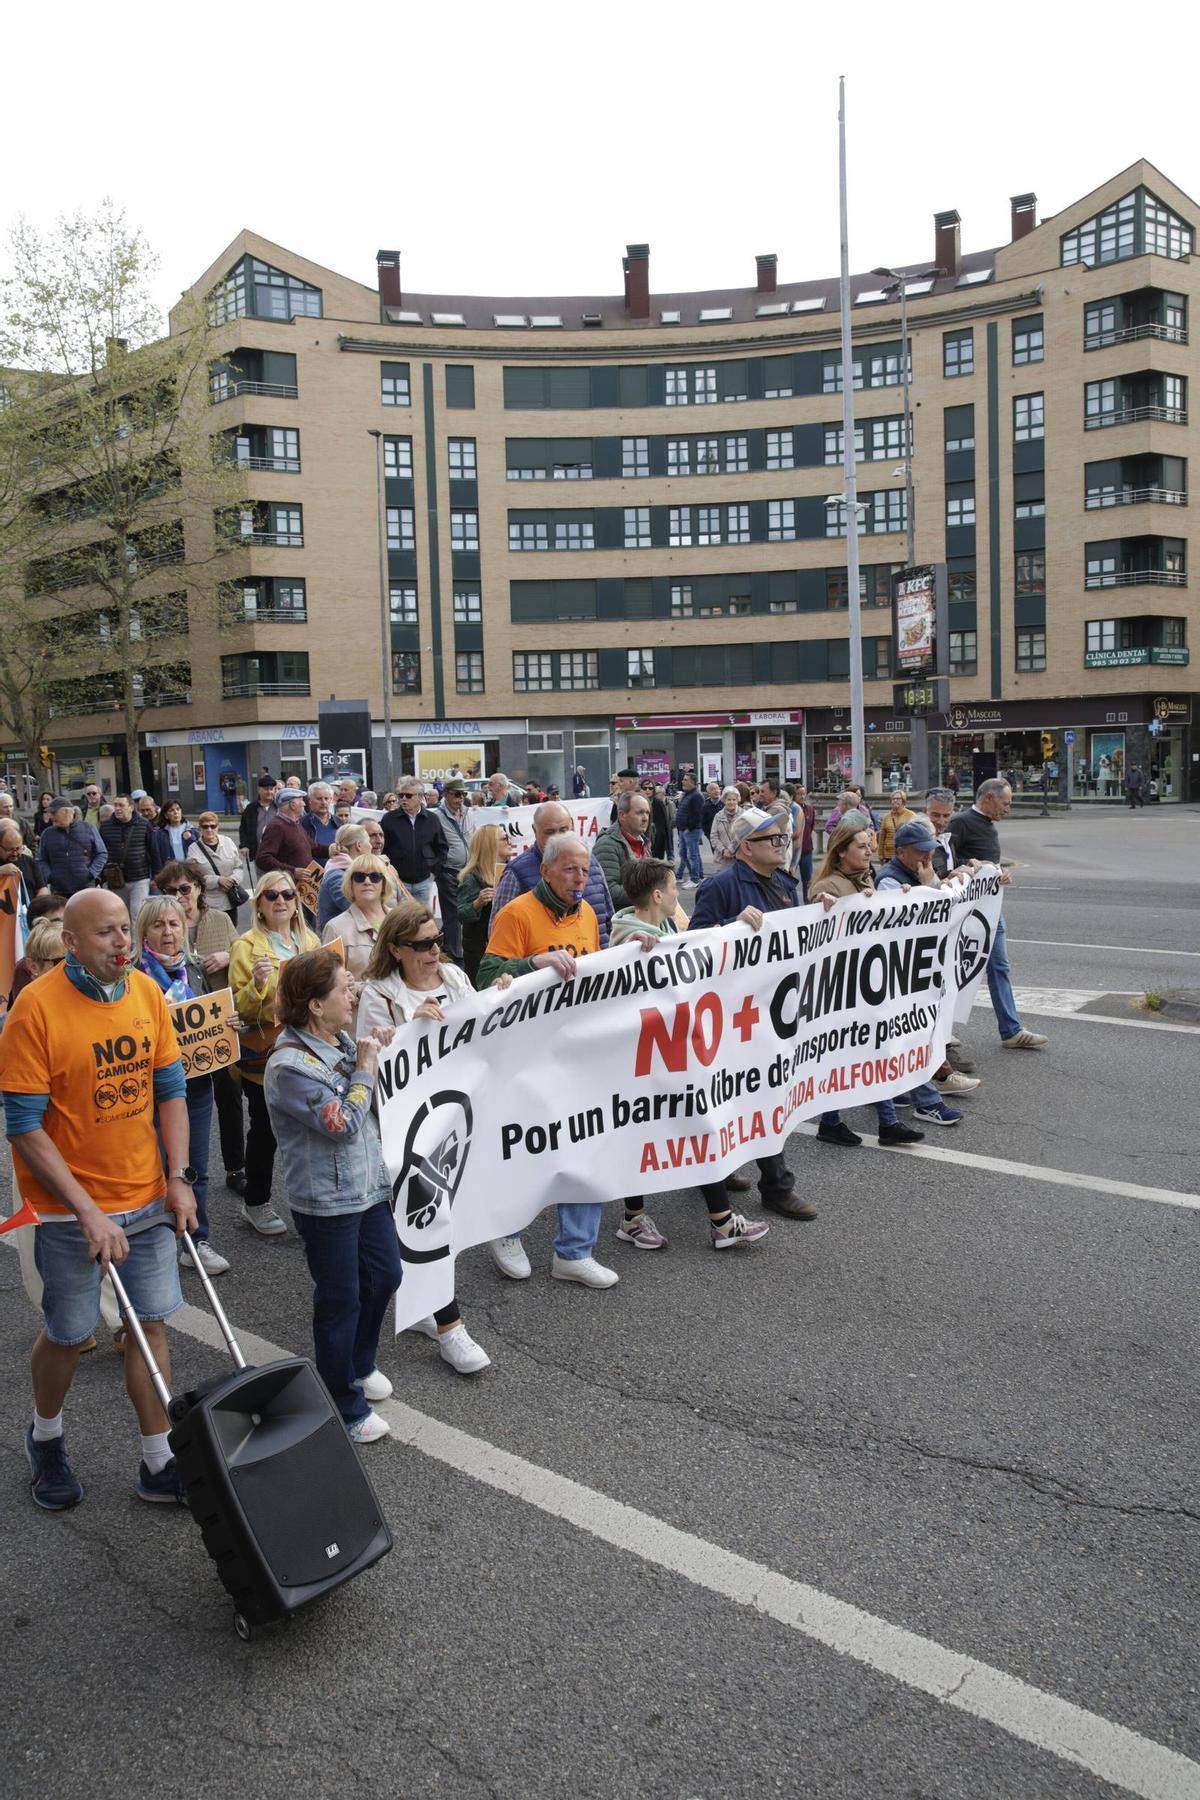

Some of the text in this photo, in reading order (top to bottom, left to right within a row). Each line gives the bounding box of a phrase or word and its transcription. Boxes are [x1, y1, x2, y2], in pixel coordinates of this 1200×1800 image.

[906, 577, 930, 593] KFC
[1086, 651, 1117, 660] CLÍNICA
[1117, 649, 1147, 657] DENTAL
[904, 688, 933, 705] 18:33
[754, 712, 786, 720] LABORAL
[171, 1004, 206, 1033] NO
[210, 1002, 221, 1019] +
[378, 1049, 409, 1105] NO
[417, 1033, 433, 1076] A
[438, 1018, 476, 1060] LA
[481, 942, 713, 1036] CONTAMINACIÓN
[733, 935, 762, 970] NO
[767, 930, 794, 963] AL
[797, 915, 836, 956] RUIDO
[845, 909, 873, 937] NO
[869, 908, 886, 932] A
[883, 903, 918, 930] LAS
[177, 1024, 224, 1047] AMIONES
[635, 991, 723, 1077] NO
[733, 995, 760, 1043] +
[92, 1035, 151, 1067] NO +
[97, 1058, 150, 1080] CAMIONES
[501, 1120, 561, 1160] Por
[568, 1106, 604, 1143] un
[612, 1084, 708, 1129] barrio
[711, 1067, 761, 1108] libre
[768, 1054, 789, 1088] de
[875, 1003, 928, 1049] pesado
[640, 1134, 716, 1173] A.V.V.
[720, 1121, 736, 1158] DE
[738, 1111, 766, 1144] LA
